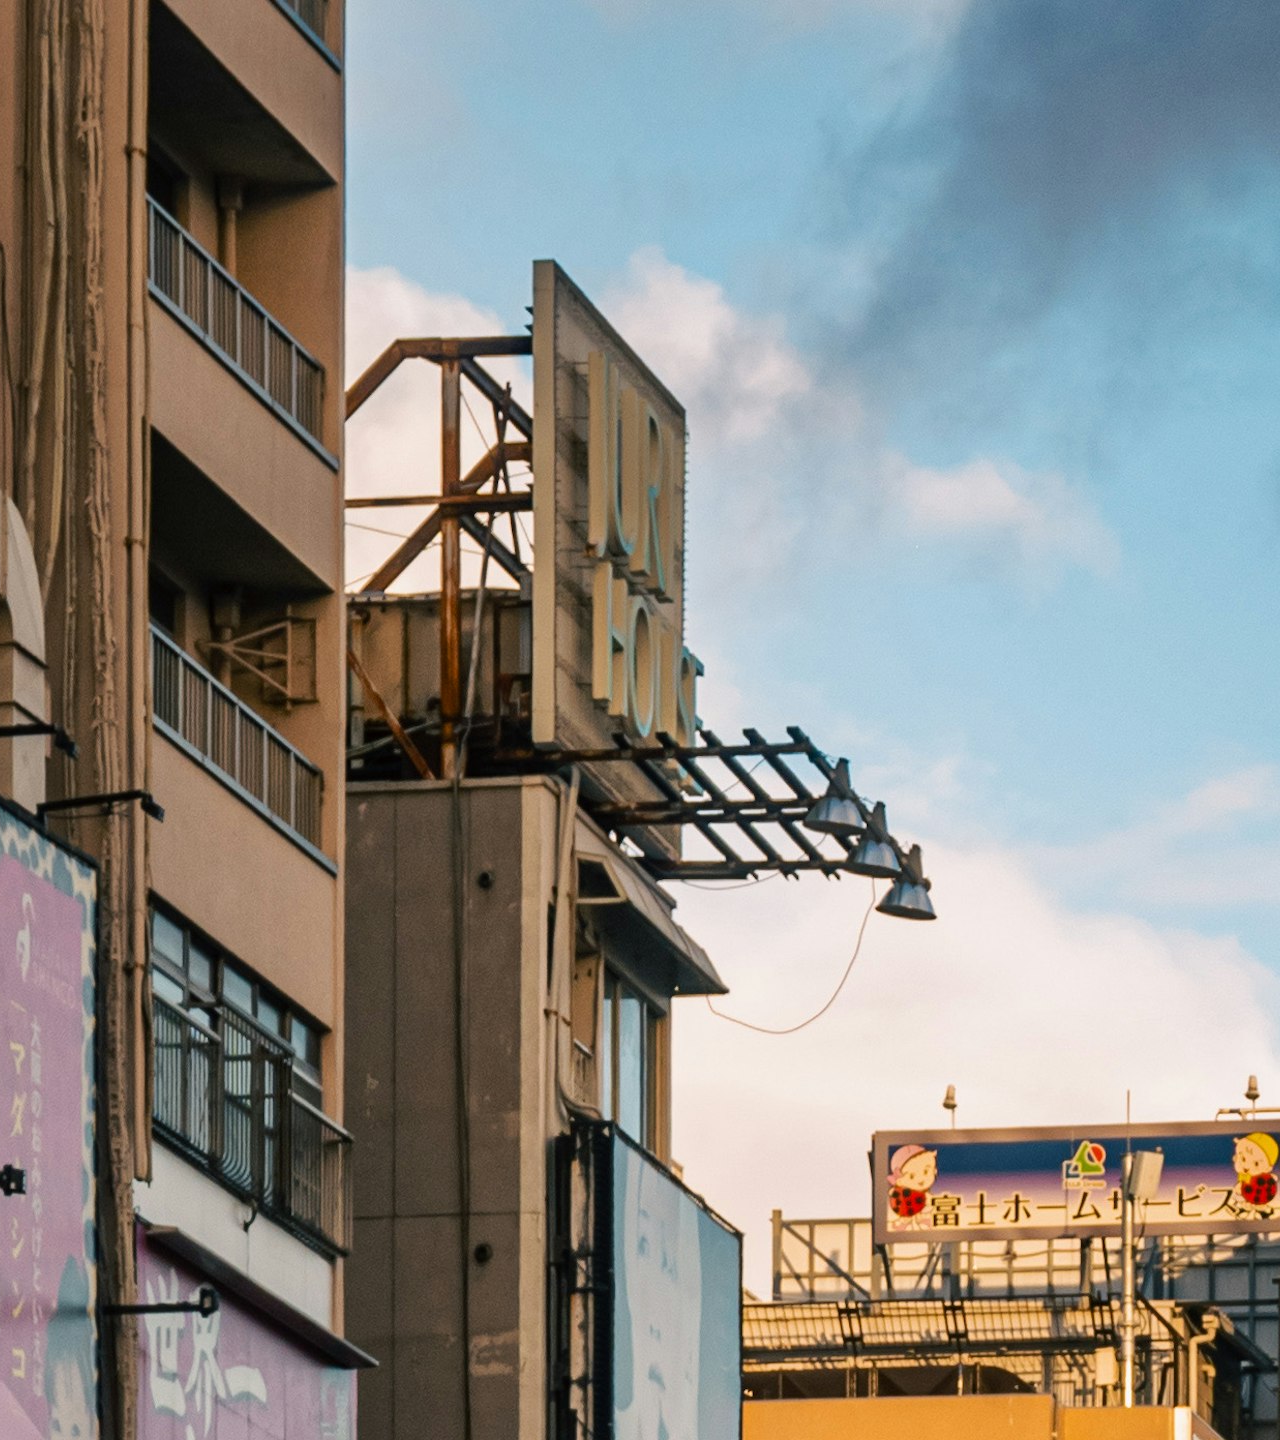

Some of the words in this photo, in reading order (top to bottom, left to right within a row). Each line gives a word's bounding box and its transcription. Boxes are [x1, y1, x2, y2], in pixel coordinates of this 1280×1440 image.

[9, 1000, 27, 1381] 「マダシンコ
[144, 1268, 267, 1437] 世界一
